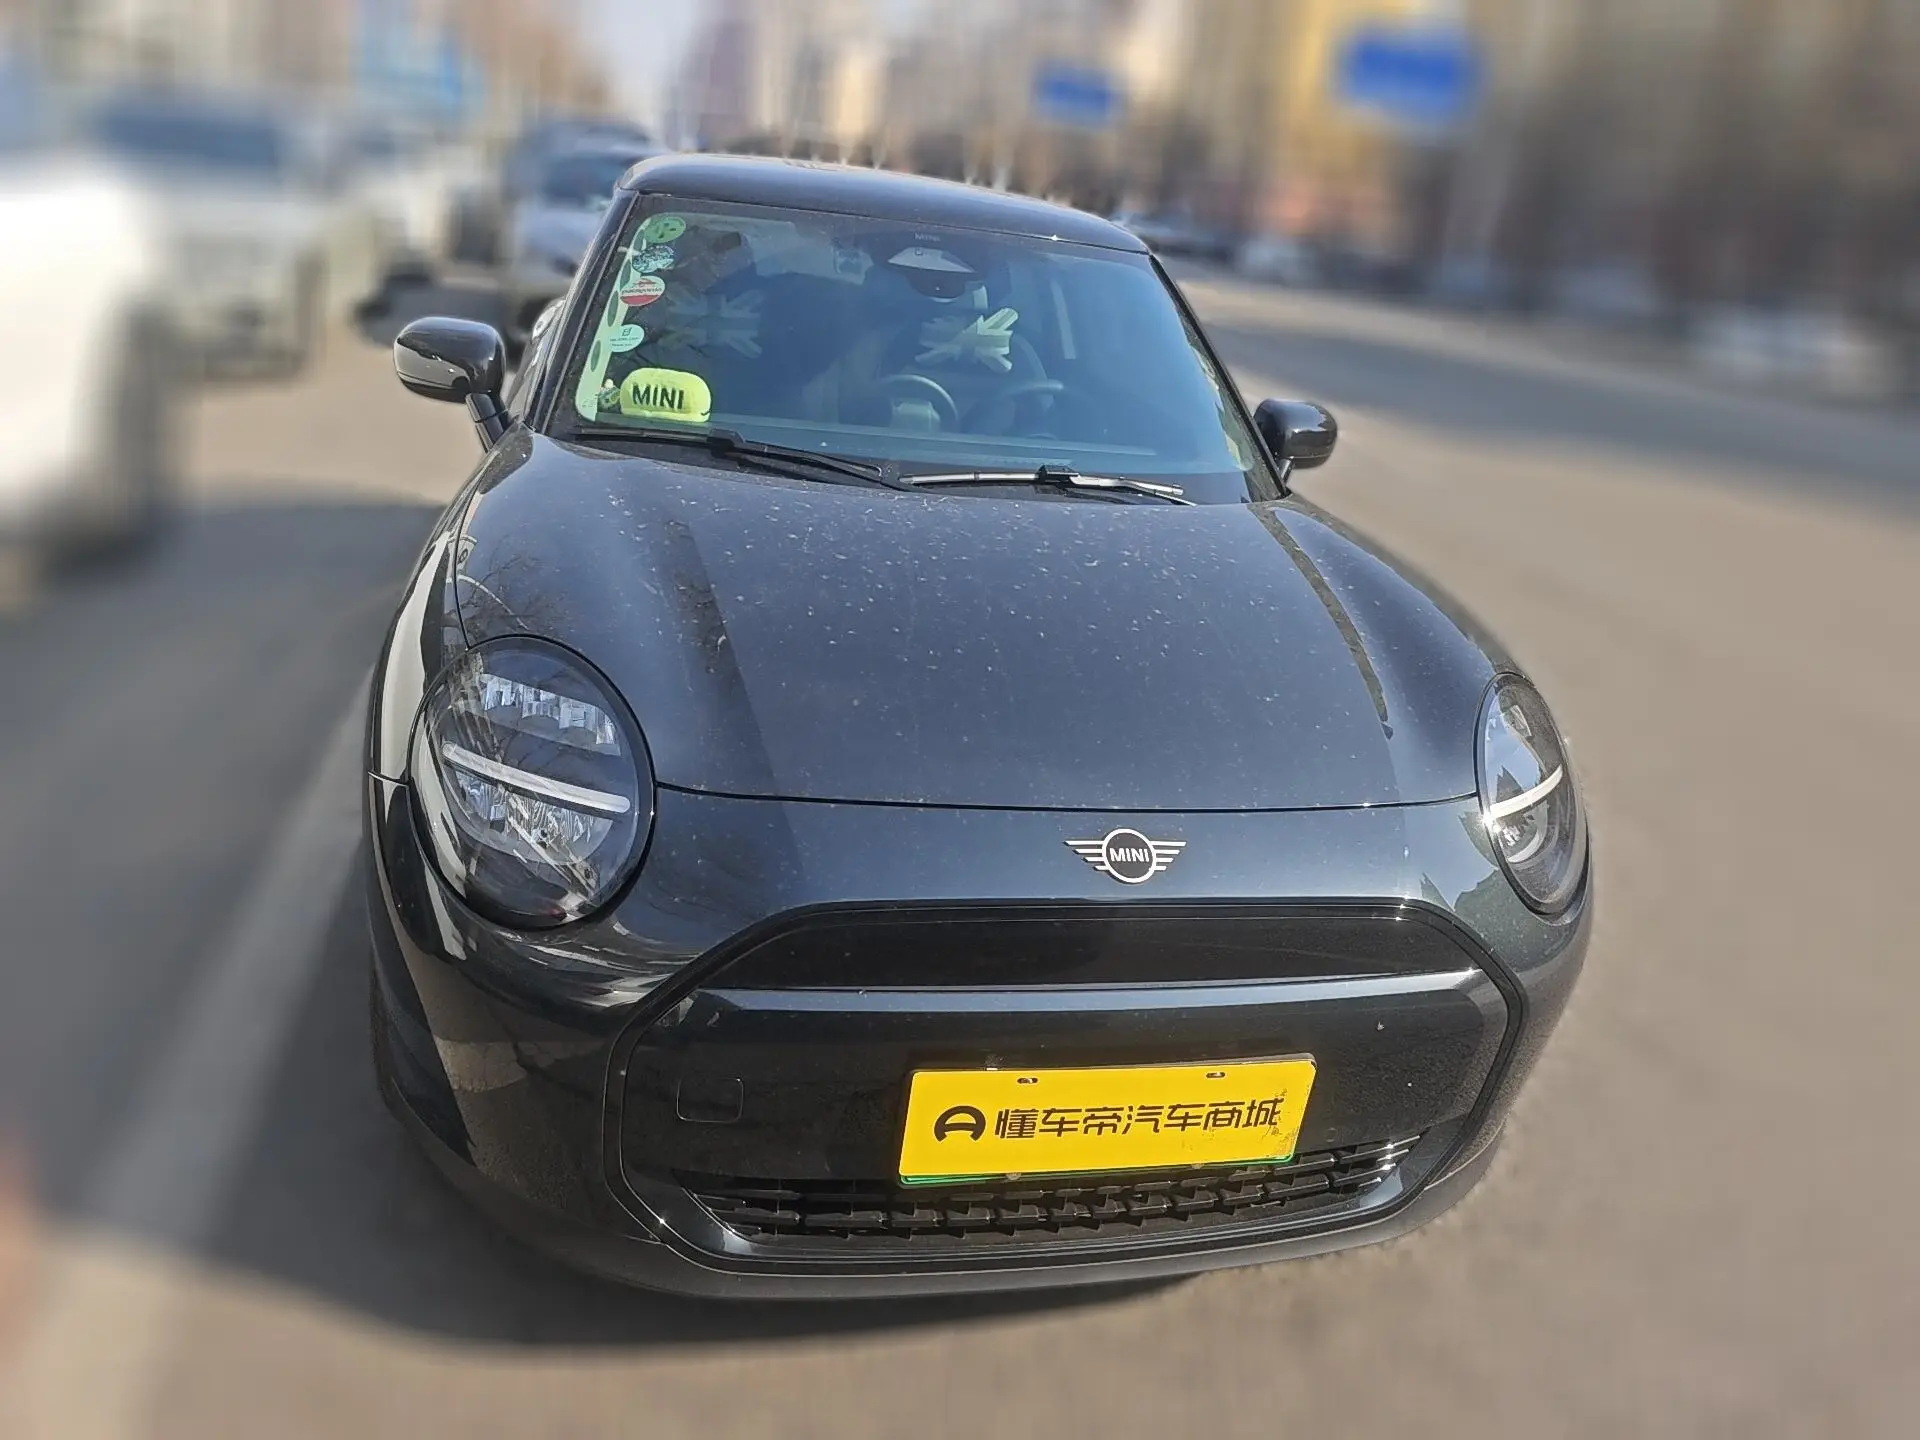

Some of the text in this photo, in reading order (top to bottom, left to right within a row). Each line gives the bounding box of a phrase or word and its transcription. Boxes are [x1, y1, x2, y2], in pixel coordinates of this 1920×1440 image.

[632, 384, 684, 409] MINI
[1109, 847, 1150, 863] MINI
[994, 1097, 1285, 1139] 懂车帝汽车商城
